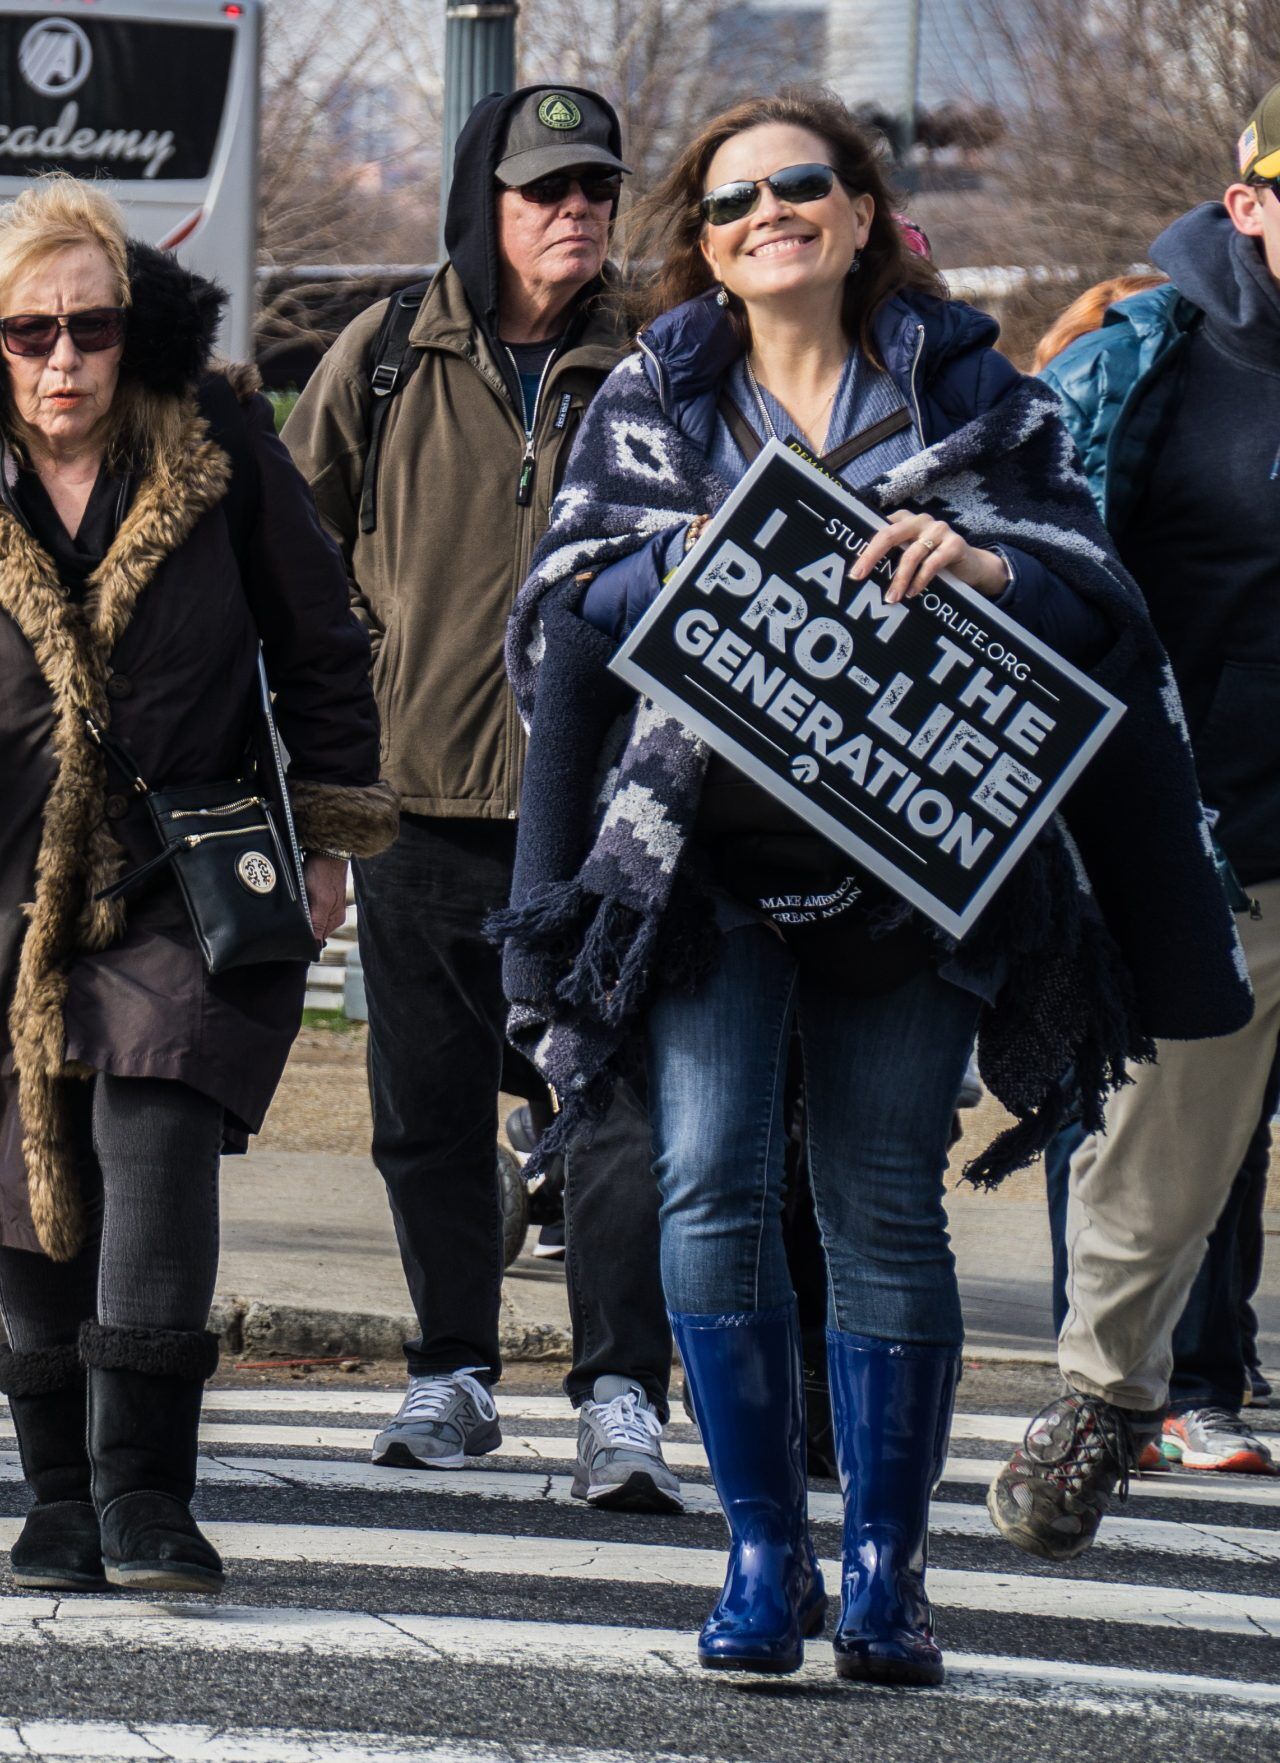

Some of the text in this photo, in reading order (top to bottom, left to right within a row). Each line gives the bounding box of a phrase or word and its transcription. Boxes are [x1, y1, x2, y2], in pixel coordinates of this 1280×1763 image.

[694, 538, 1042, 828] PRO-LIFE
[753, 508, 1057, 756] I AM THE
[824, 517, 1032, 683] STUNORLIFE.ORG
[674, 608, 994, 870] GENERATION
[760, 876, 856, 908] MAKE AMERICA
[772, 886, 863, 923] GREAT AGAIN
